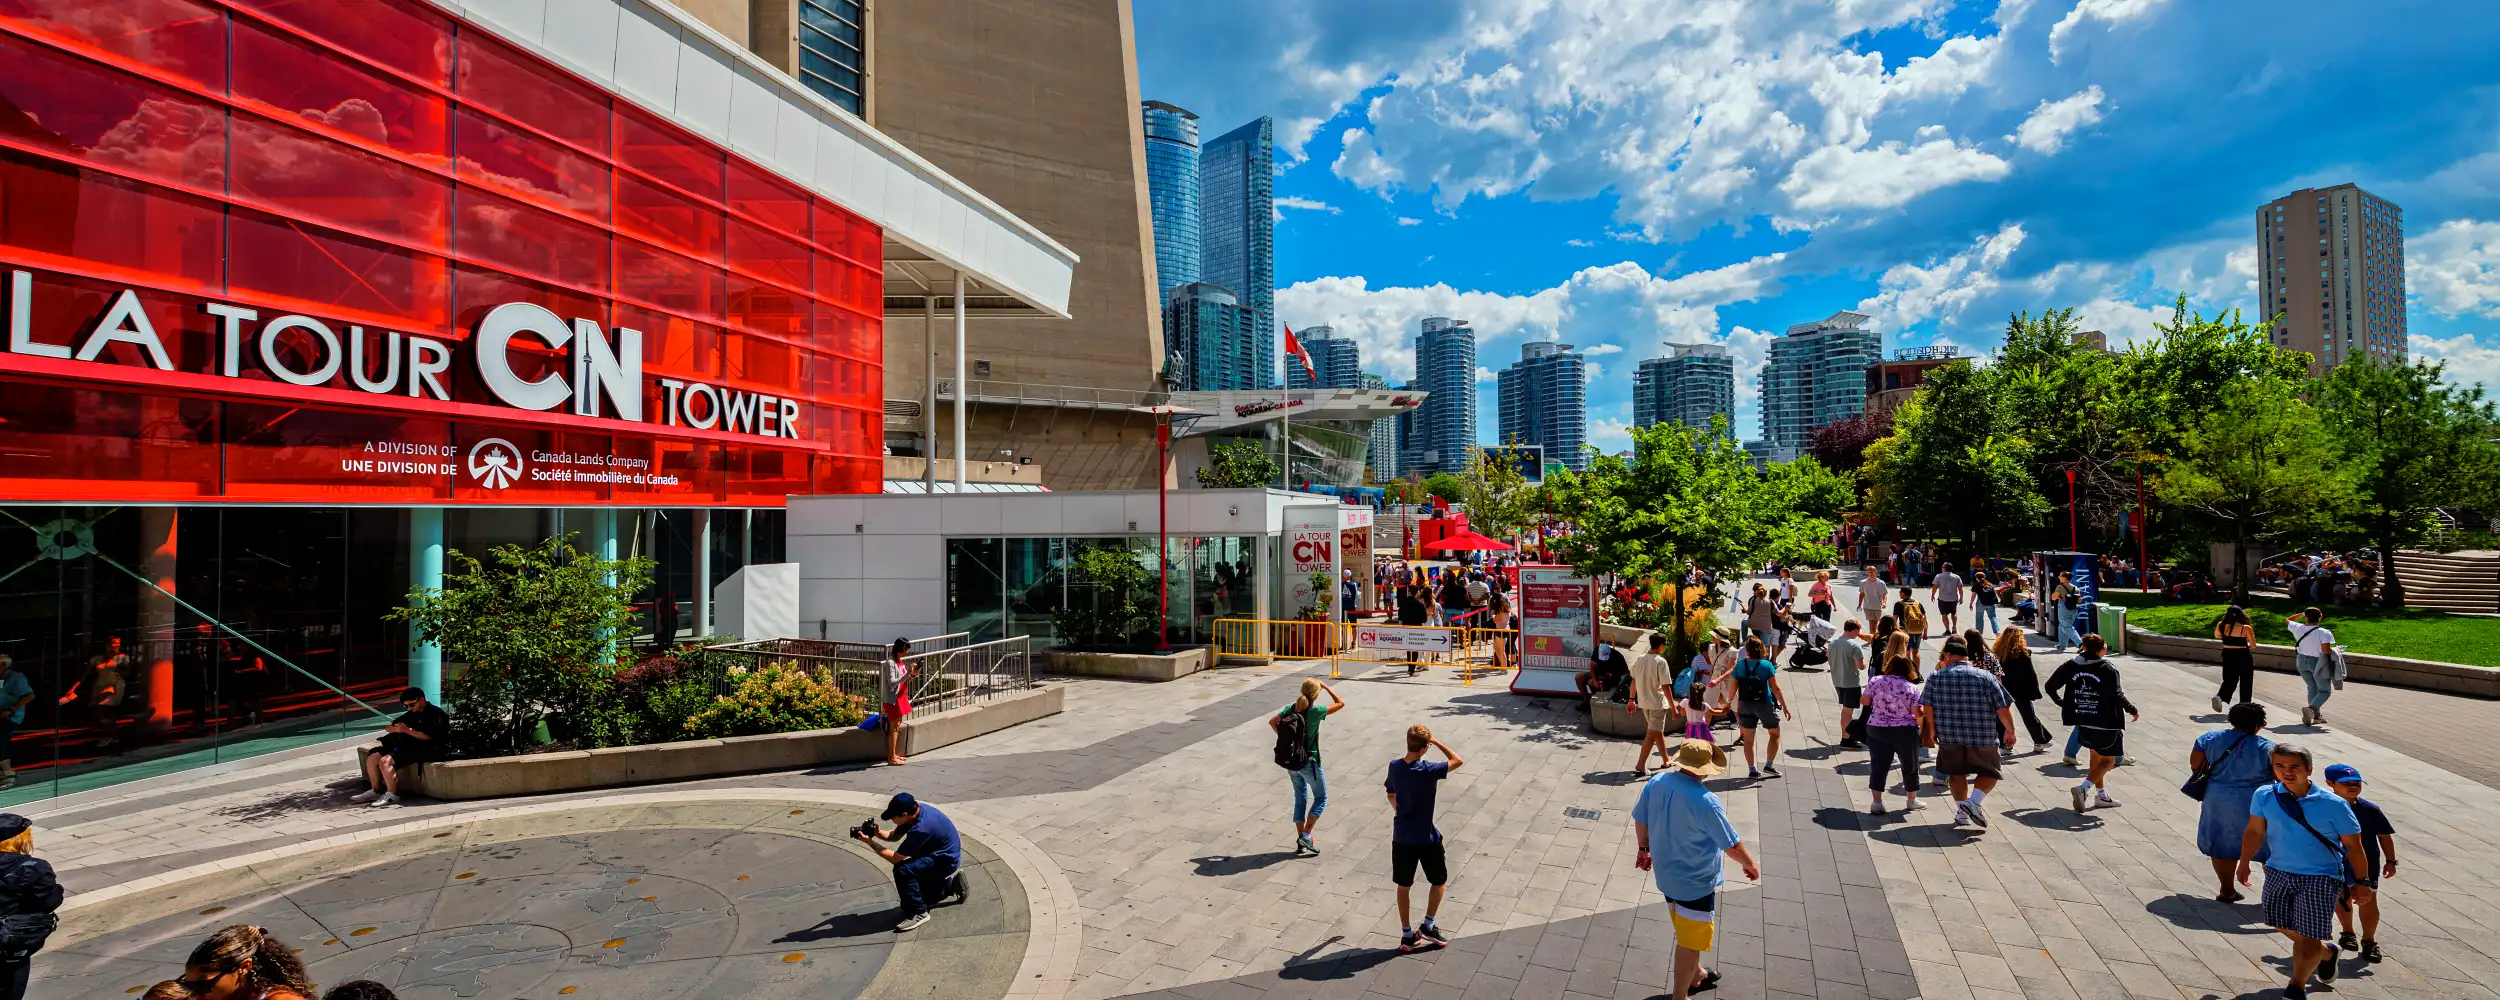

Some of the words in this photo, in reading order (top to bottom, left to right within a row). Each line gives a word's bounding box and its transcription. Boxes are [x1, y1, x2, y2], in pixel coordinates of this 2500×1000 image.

[10, 270, 174, 371] LA
[206, 303, 451, 401] TOUR
[476, 302, 643, 421] CN
[662, 379, 799, 439] TOWER
[364, 440, 374, 453] A
[378, 441, 437, 456] DIVISION
[441, 443, 457, 457] OF
[342, 459, 373, 472] UNE
[377, 461, 437, 475] DIVISION
[440, 464, 457, 475] DE
[531, 449, 573, 464] Canada
[574, 451, 604, 465] Lands
[606, 453, 649, 470] Company
[531, 467, 571, 482] Société
[574, 466, 632, 484] immobilière
[633, 472, 645, 484] du
[647, 472, 678, 486] Canada
[1294, 532, 1306, 541] LA
[1308, 532, 1331, 541] TOUR
[1341, 533, 1367, 549] CN
[1292, 541, 1332, 563] CN
[1295, 563, 1332, 573] TOWER
[1360, 631, 1376, 642] CN
